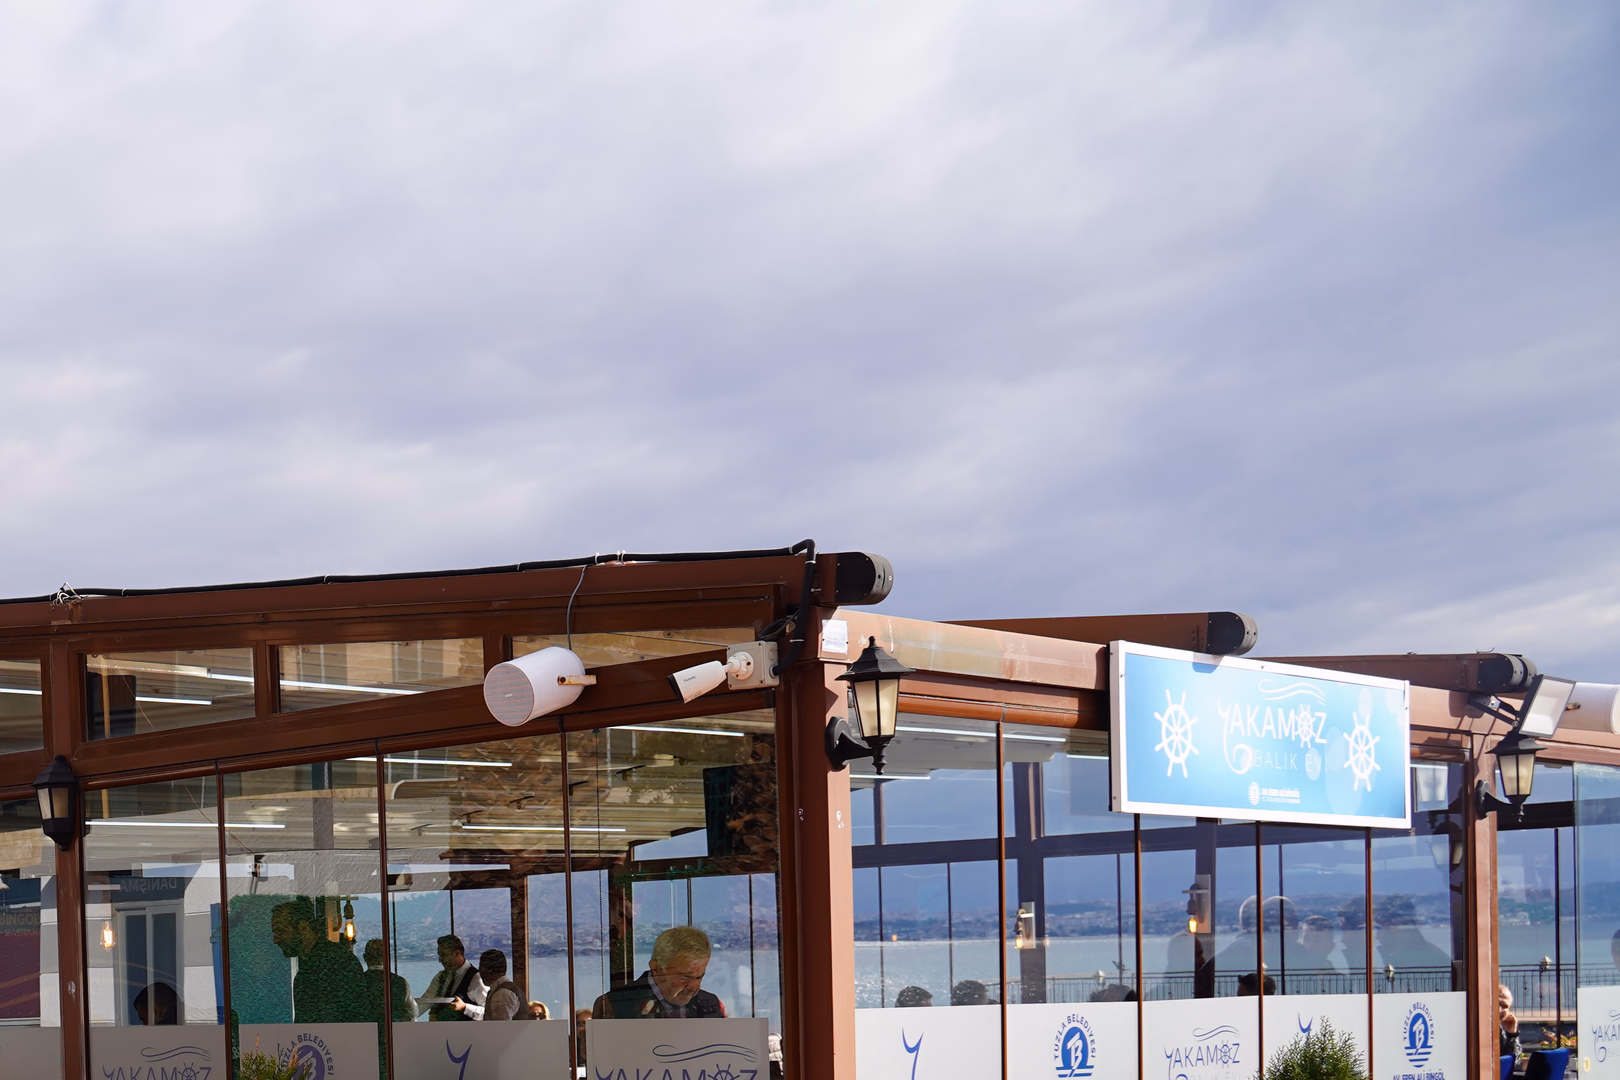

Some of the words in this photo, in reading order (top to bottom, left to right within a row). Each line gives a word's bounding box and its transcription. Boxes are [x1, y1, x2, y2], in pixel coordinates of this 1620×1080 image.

[1217, 698, 1328, 775] YAKAMOZ
[1254, 749, 1298, 771] BALIK
[1054, 1022, 1067, 1061] TUZLA
[1403, 1009, 1413, 1042] TUZLA
